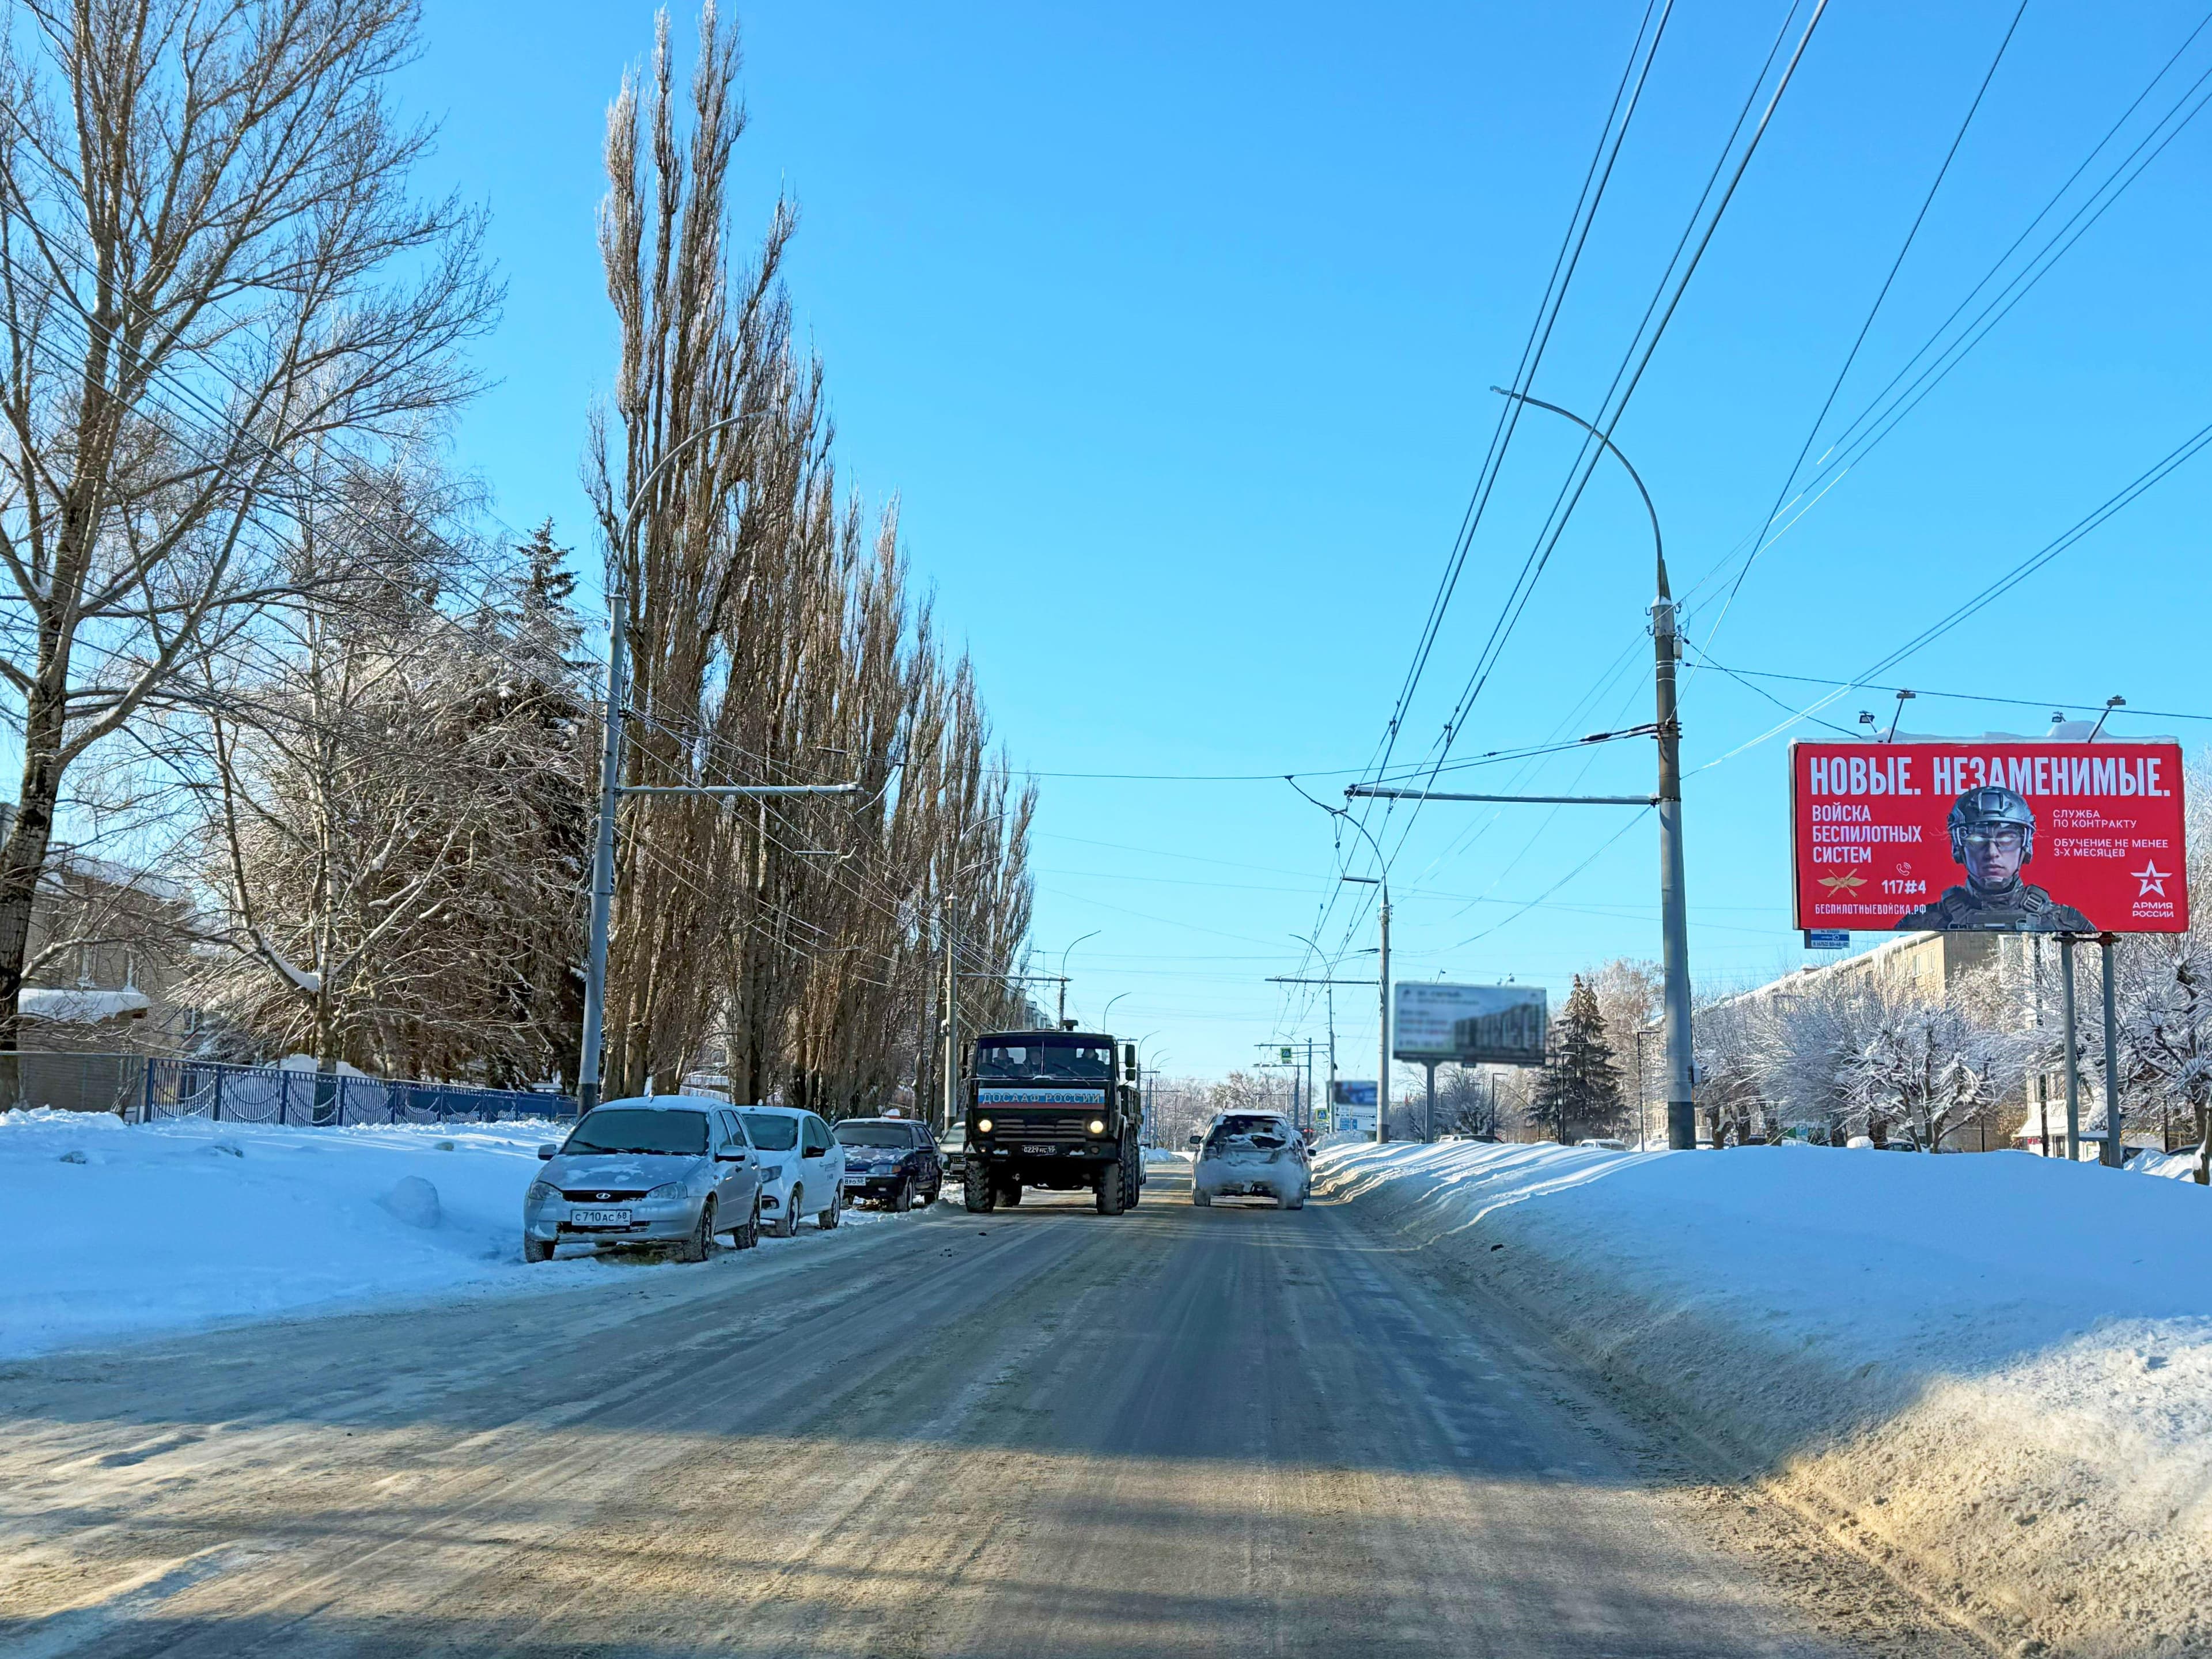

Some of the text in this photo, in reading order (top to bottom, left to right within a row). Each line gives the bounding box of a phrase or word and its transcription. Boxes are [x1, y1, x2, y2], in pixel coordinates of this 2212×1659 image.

[1810, 756, 2171, 797] НОВЫЕ. НЕЗАМЕНИМЫЕ.
[1812, 802, 1872, 822] ВОЙСКА
[2052, 809, 2100, 819] СЛУЖБА
[2053, 819, 2137, 829] ПО КОНТРАКТУ
[1812, 825, 1923, 843] БЕСПИЛОТНЫХ
[2054, 838, 2169, 849] ОБУЧЕНИЕ НЕ МЕНЕЕ
[1813, 846, 1872, 863] СИСТЕМ
[2074, 849, 2126, 858] МЕСЯЦЕВ
[1881, 880, 1927, 895] 117#4
[1815, 903, 1927, 915] БЕСПИЛОТНЫЕВОЙСКА.РФ
[2133, 902, 2173, 910] АРМИЯ
[982, 1092, 1100, 1104] ДОСААФ РОССИИ
